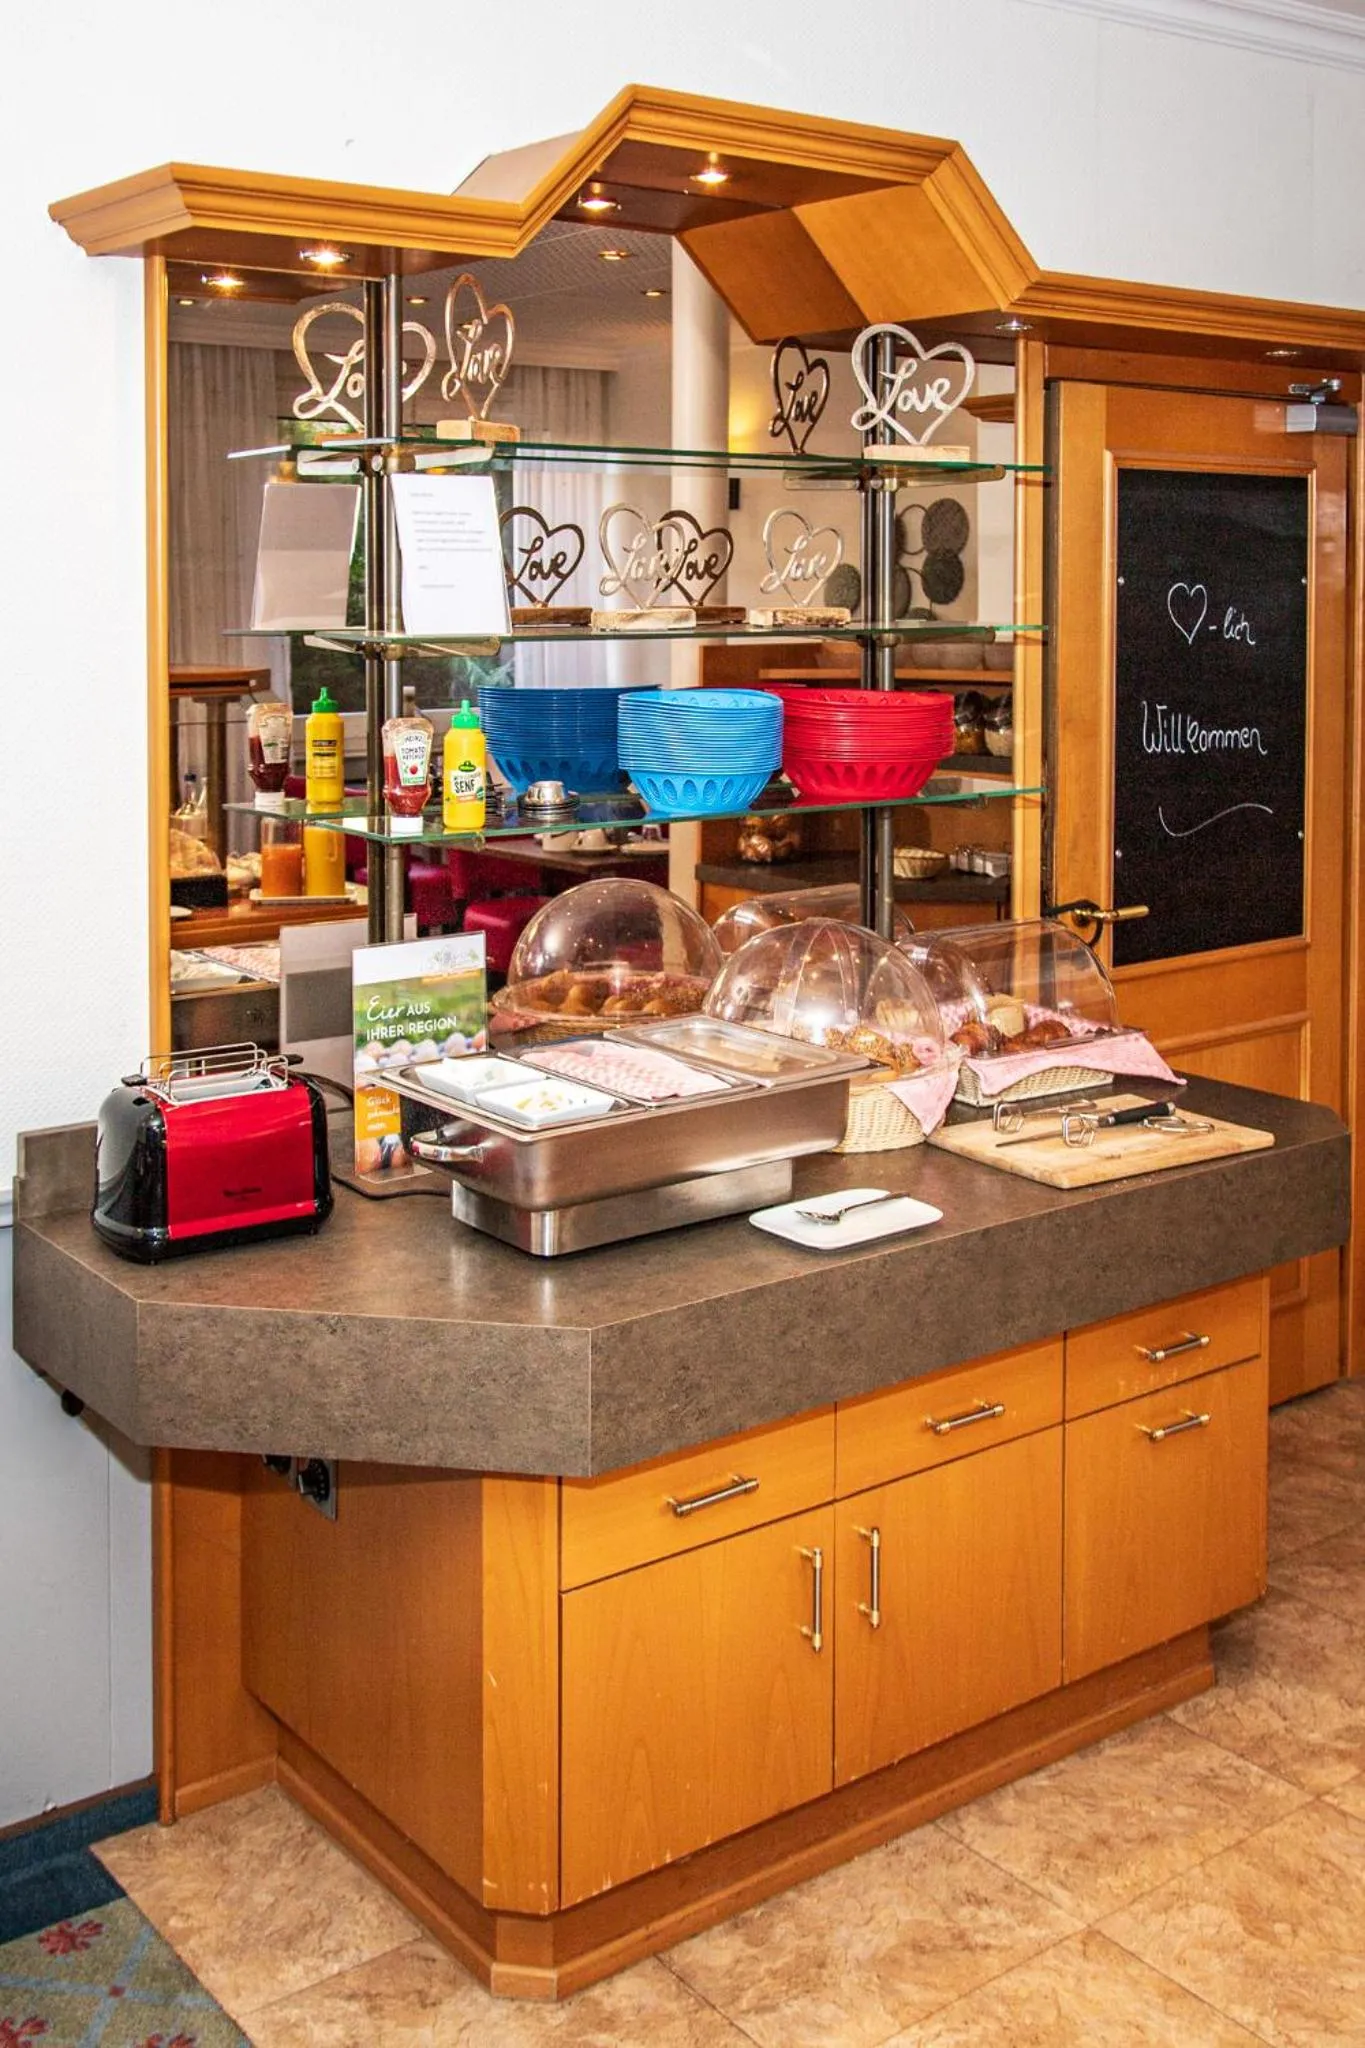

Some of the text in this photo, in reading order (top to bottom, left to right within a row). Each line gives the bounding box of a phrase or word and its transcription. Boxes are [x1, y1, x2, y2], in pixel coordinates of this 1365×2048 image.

[513, 536, 567, 583] Love
[668, 538, 719, 584] Love
[1142, 700, 1268, 755] Willkommen
[454, 779, 475, 793] SENF
[367, 995, 431, 1021] Eier AUS
[366, 1016, 457, 1041] IHRER REGION
